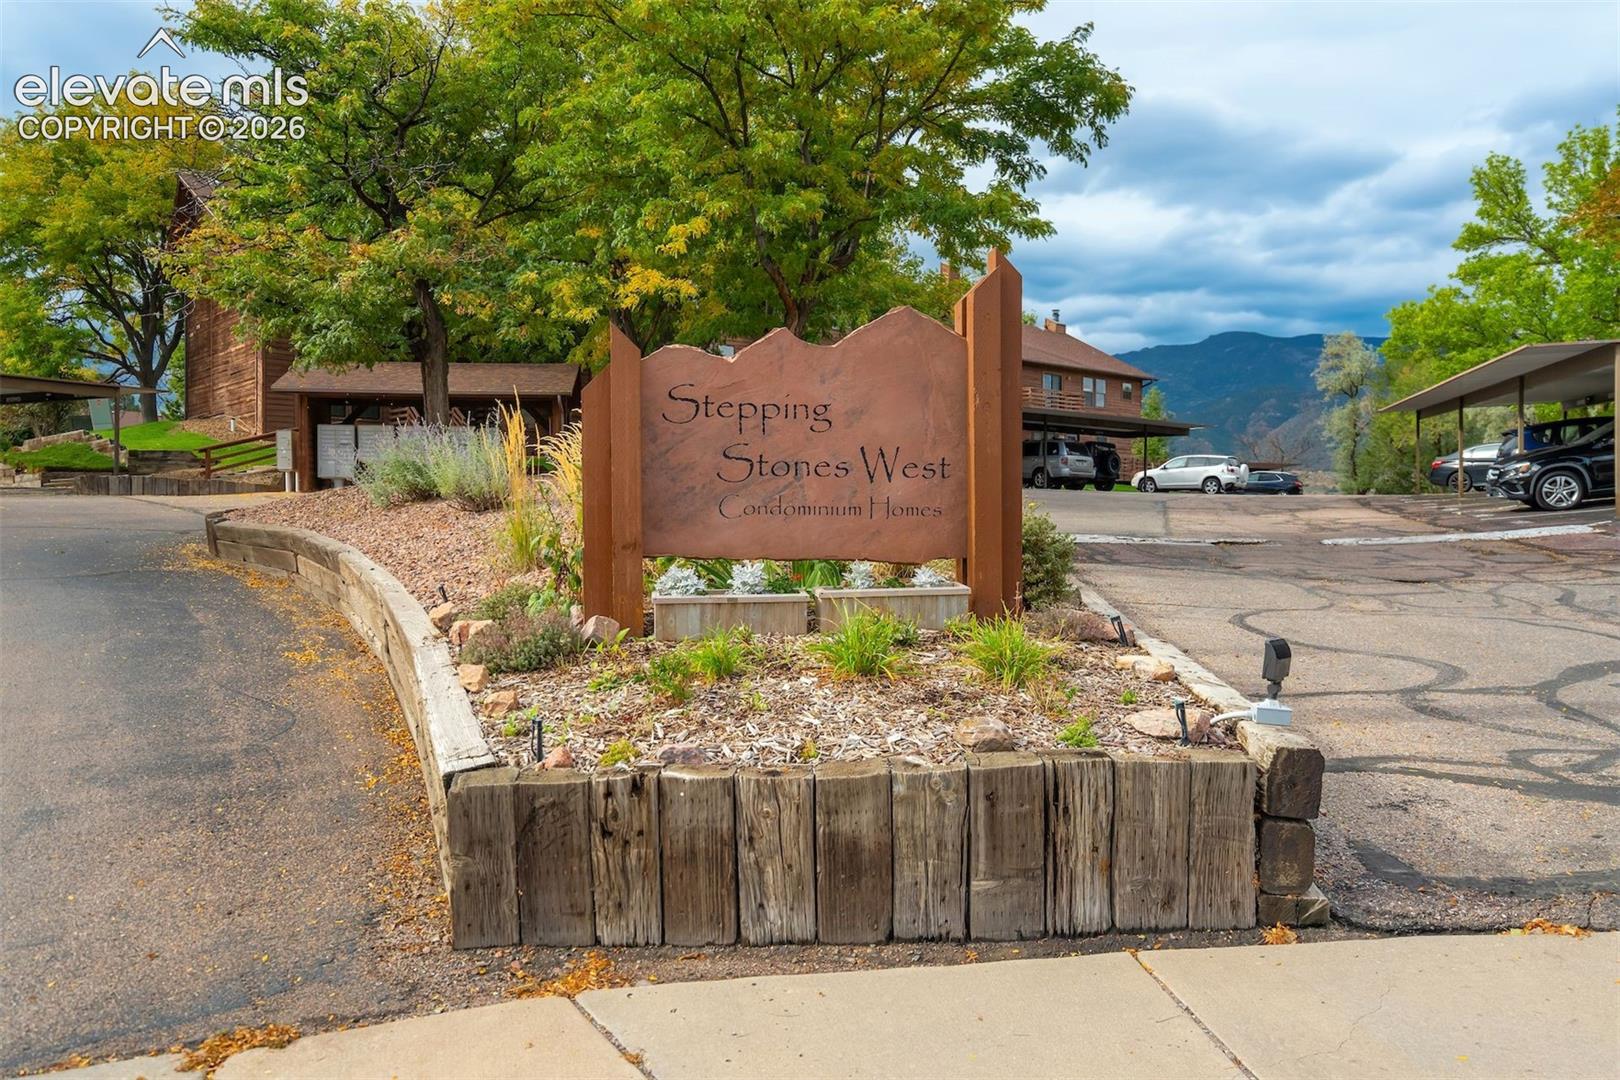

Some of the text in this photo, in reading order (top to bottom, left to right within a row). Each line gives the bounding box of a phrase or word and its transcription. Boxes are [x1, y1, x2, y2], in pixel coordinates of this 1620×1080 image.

[662, 383, 832, 435] Stepping
[716, 443, 951, 484] Stones West
[718, 494, 943, 520] Condominium Homes
